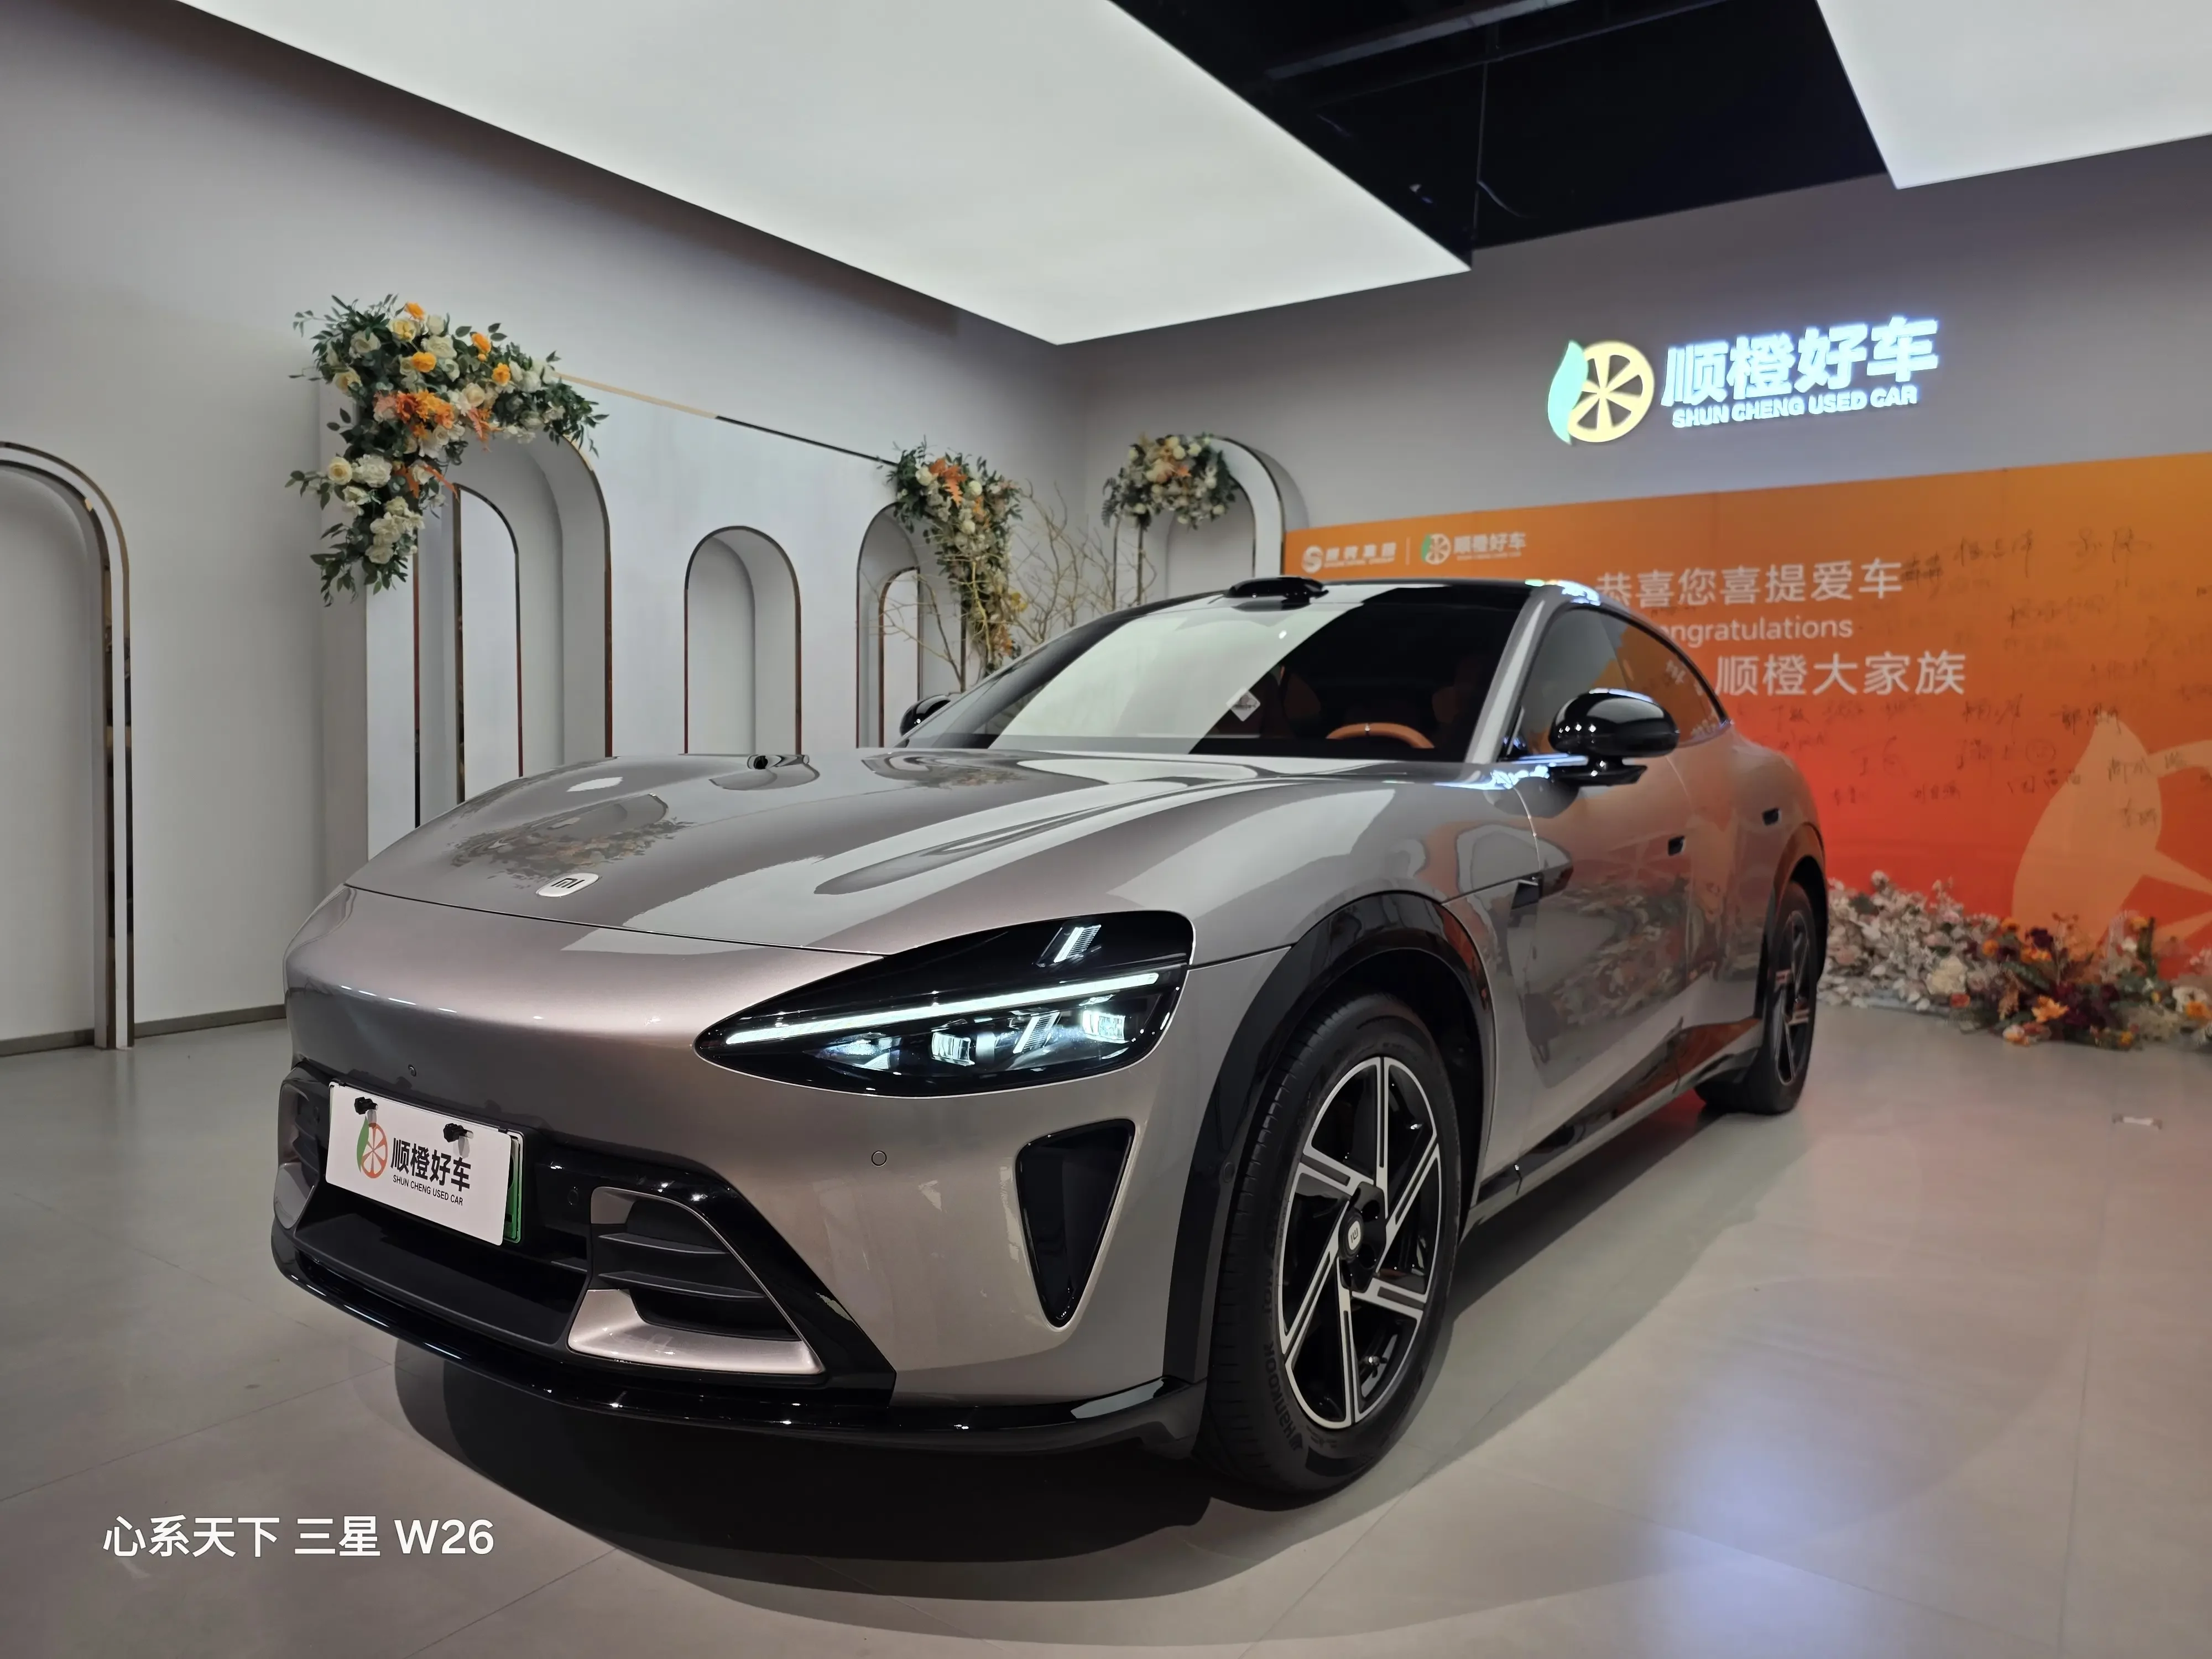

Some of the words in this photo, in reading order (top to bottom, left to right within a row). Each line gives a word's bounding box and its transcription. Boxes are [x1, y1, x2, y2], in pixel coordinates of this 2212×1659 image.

[1661, 315, 1938, 406] 顺橙好车
[1672, 403, 1729, 429] SHUN
[1731, 397, 1805, 422] CHENG
[1808, 391, 1867, 415] USED
[1870, 385, 1918, 409] CAR
[1597, 557, 1903, 608] 恭喜您喜提爱车
[1714, 649, 1966, 696] 顺橙大家族
[390, 1137, 472, 1192] 顺橙好车
[393, 1174, 409, 1188] SHUN
[410, 1180, 431, 1196] CHENG
[432, 1188, 449, 1201] USED
[450, 1194, 463, 1206] CAR
